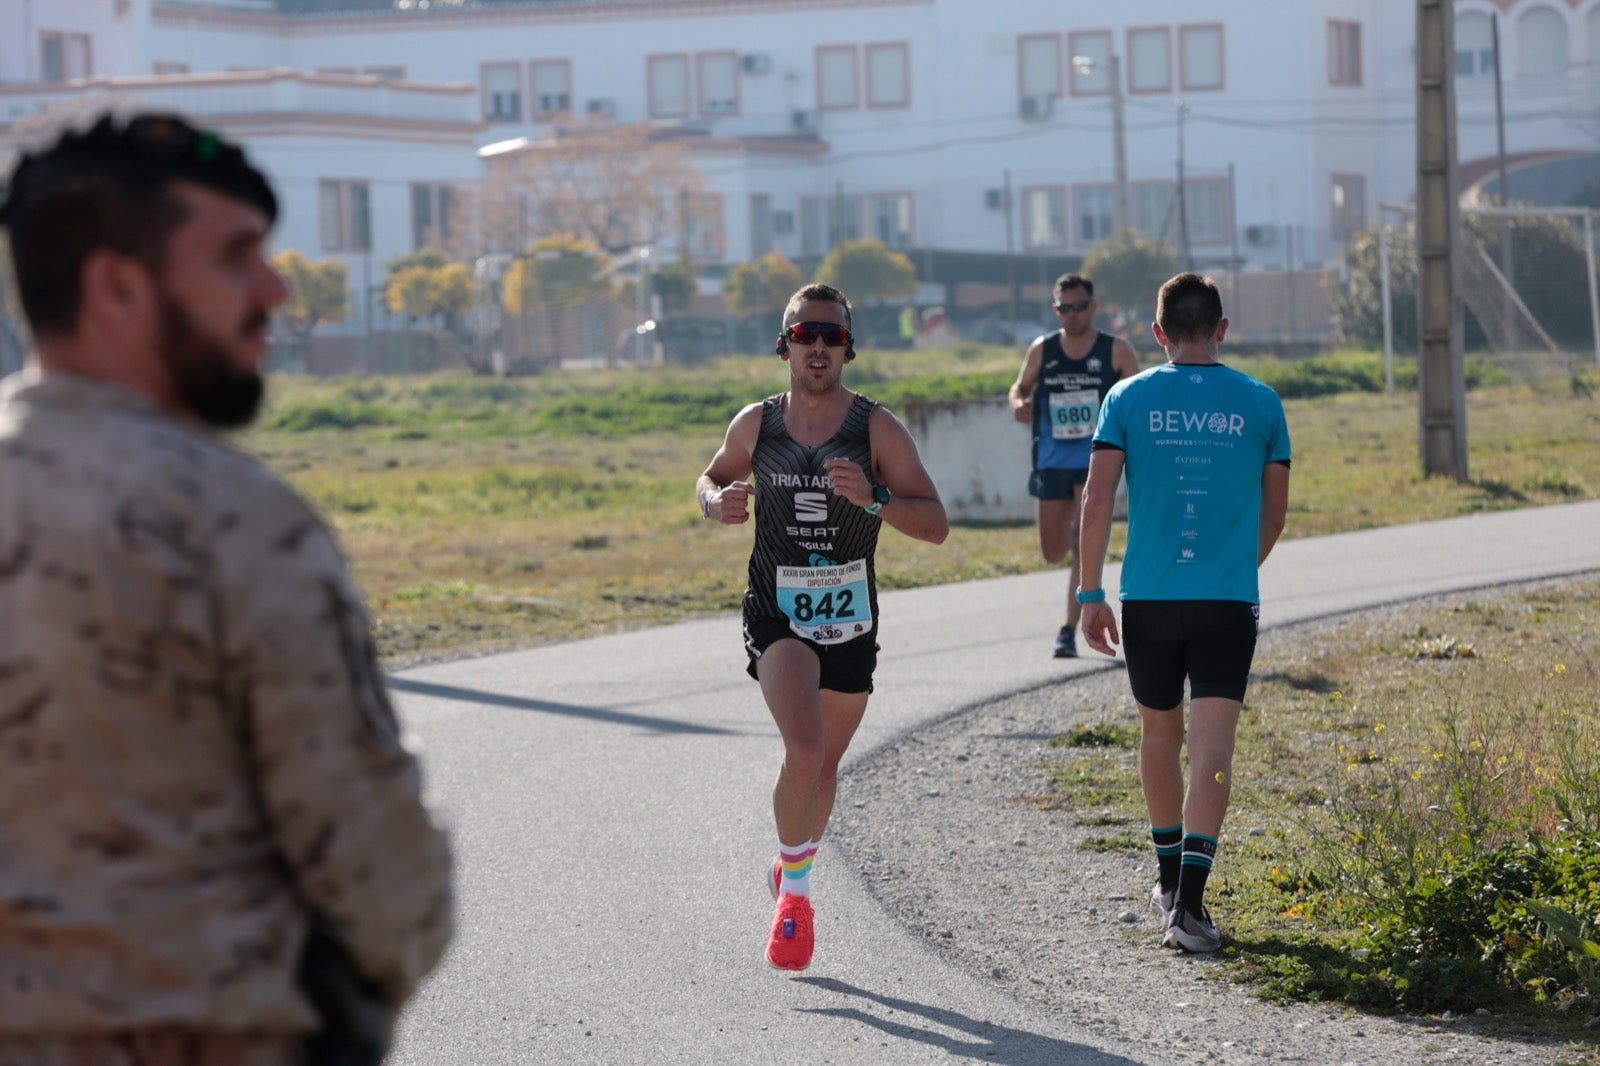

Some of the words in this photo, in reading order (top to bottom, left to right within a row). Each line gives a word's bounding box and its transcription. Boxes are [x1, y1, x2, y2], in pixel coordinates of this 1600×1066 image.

[1057, 406, 1091, 424] 680
[1149, 410, 1245, 437] BEWOR
[786, 526, 840, 537] SEAT
[800, 570, 815, 578] GRAN
[816, 569, 837, 578] PREMIO
[839, 568, 845, 576] DE
[807, 577, 841, 587] DIPUTACIÓN
[794, 589, 855, 622] 842
